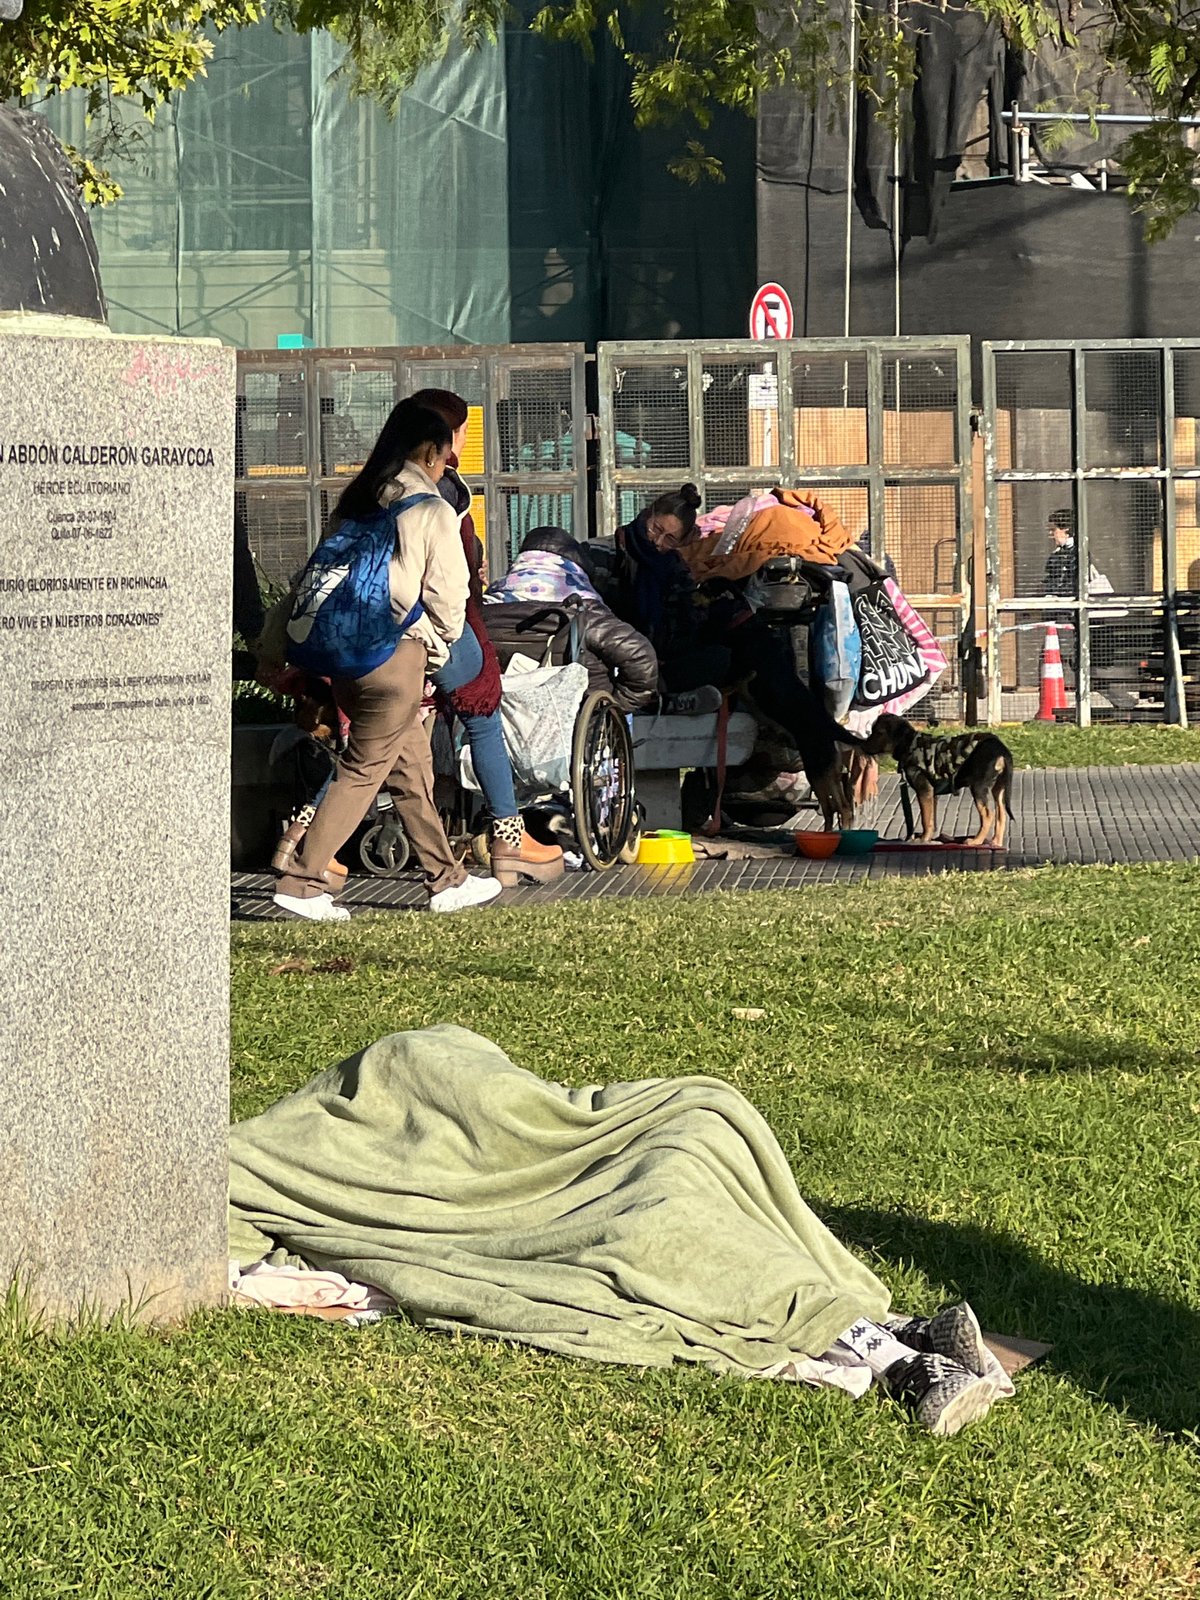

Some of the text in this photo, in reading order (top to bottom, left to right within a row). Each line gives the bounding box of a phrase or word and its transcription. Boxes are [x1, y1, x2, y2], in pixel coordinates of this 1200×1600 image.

[8, 439, 58, 465] ABDÓN
[141, 446, 215, 467] GARAYCOA
[67, 480, 131, 496] ECUATORIANO
[27, 577, 105, 593] GLORIOSAMENTE
[106, 576, 119, 590] EN
[17, 615, 38, 630] VIVE
[40, 614, 53, 629] EN
[55, 614, 103, 628] NUESTROS
